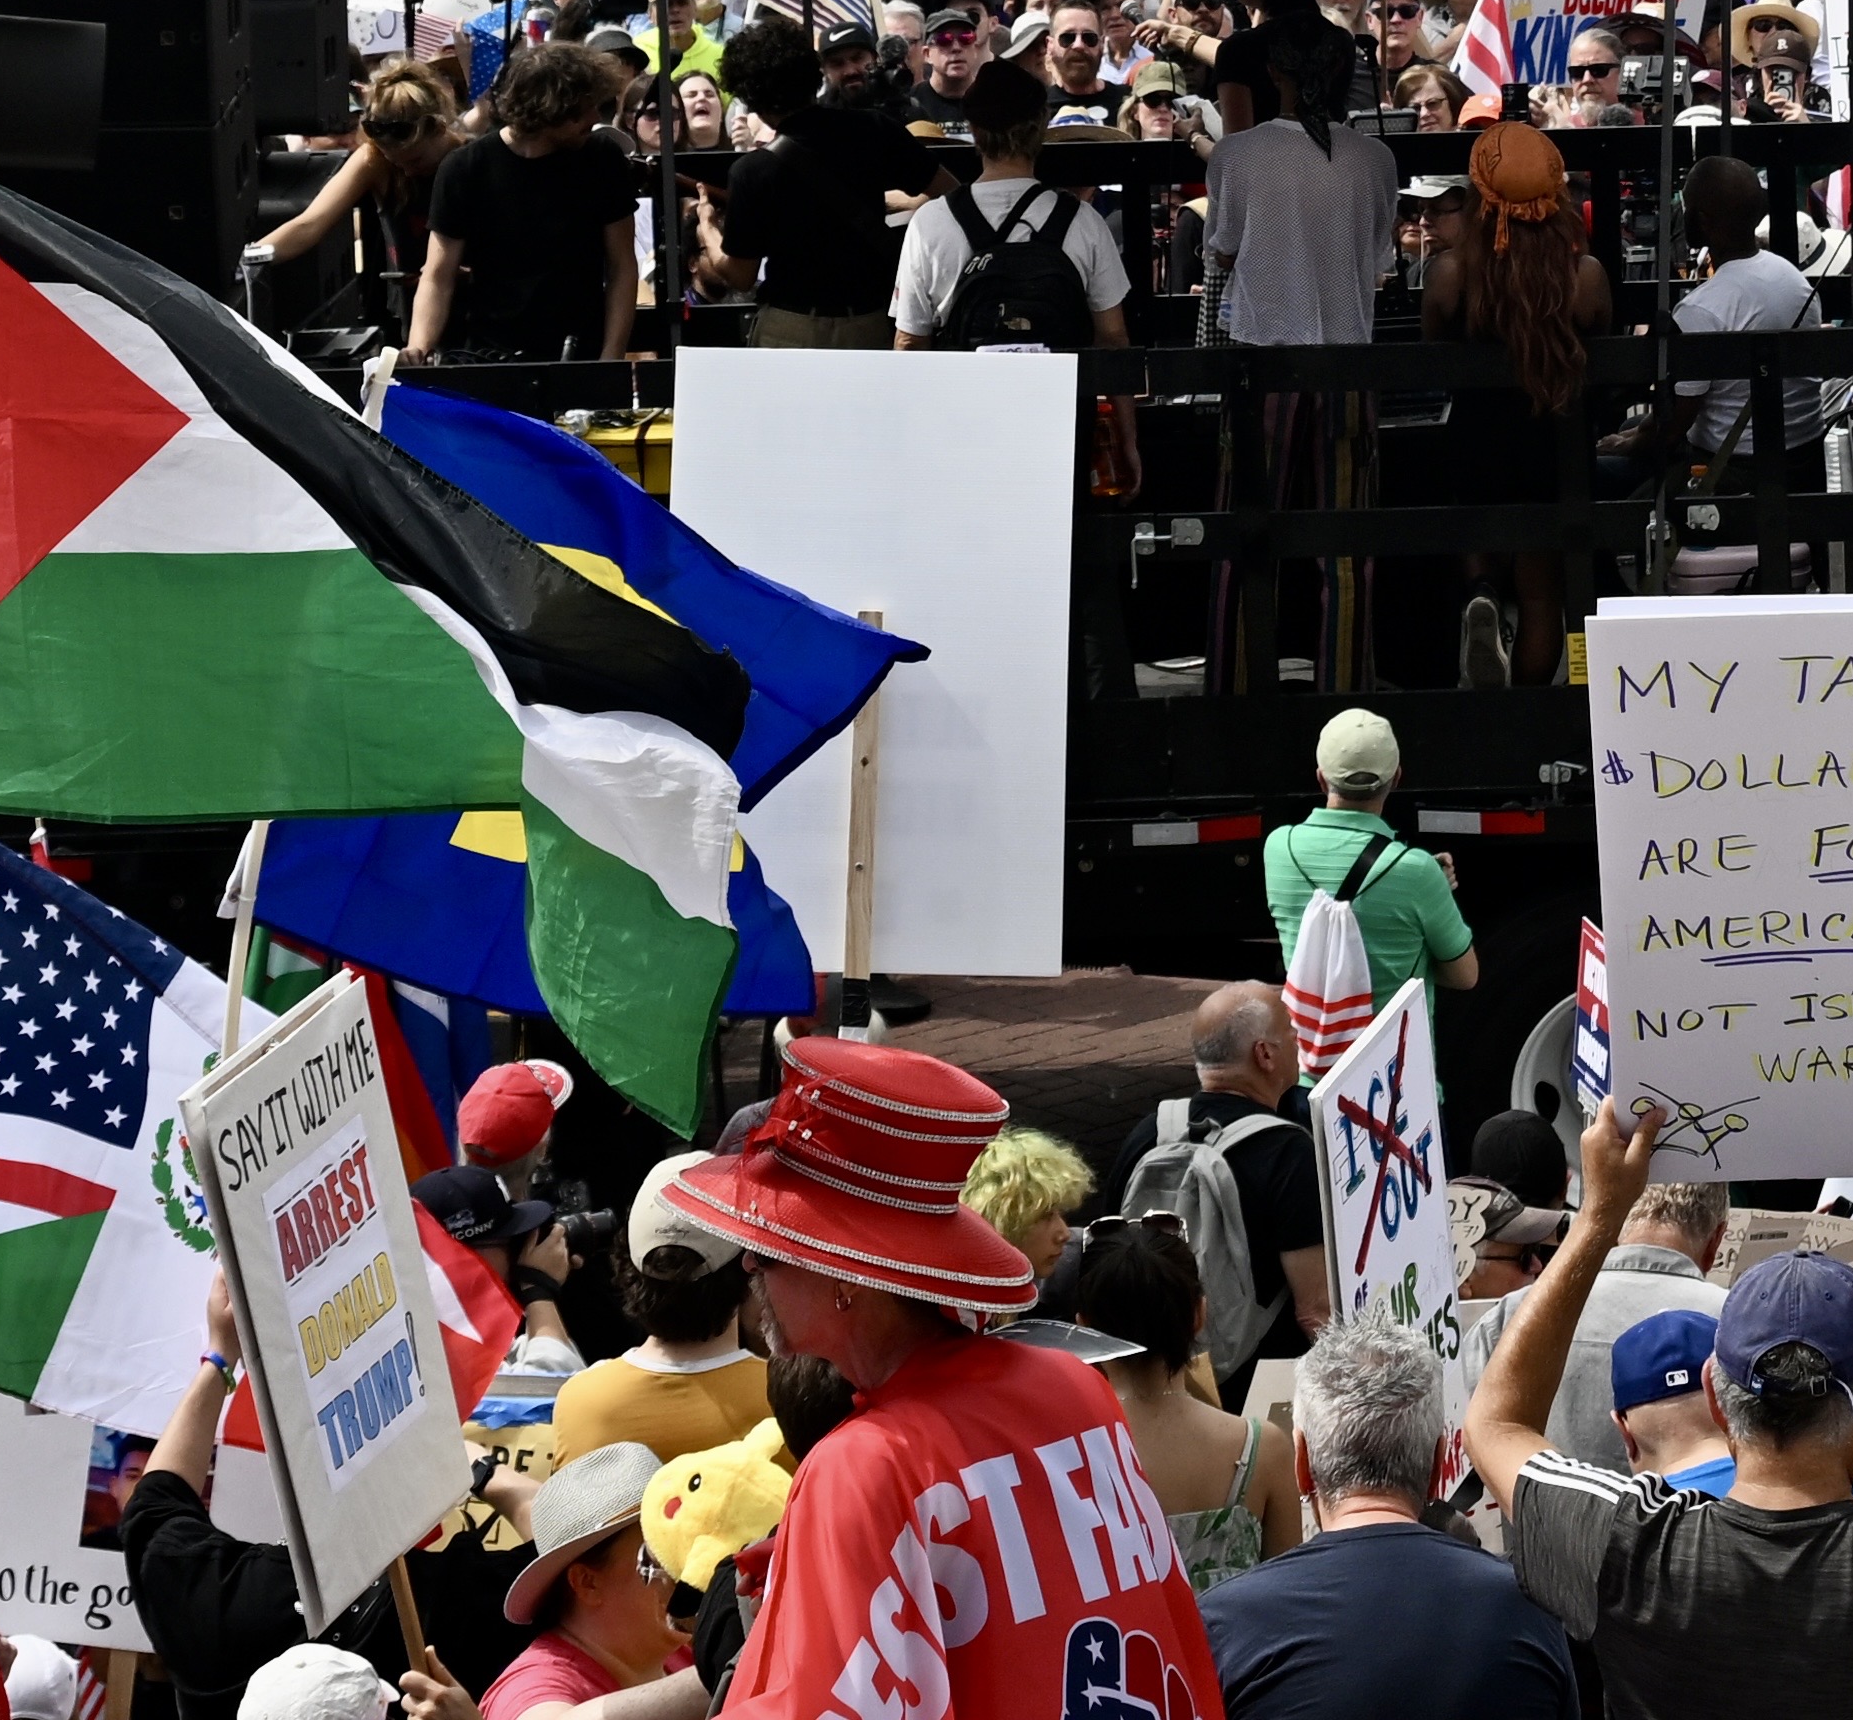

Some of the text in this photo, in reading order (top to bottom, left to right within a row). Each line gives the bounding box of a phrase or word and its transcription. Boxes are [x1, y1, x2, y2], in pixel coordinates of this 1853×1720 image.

[1616, 660, 1740, 714] MY
[1637, 834, 1759, 881] ARE
[1635, 1003, 1758, 1041] NOT
[217, 1105, 267, 1192] SAY
[264, 1084, 292, 1152] IT
[293, 1044, 342, 1135] WITH
[275, 1143, 377, 1282] ARREST
[298, 1251, 398, 1379] DONALD
[317, 1311, 427, 1470] TRUMP!
